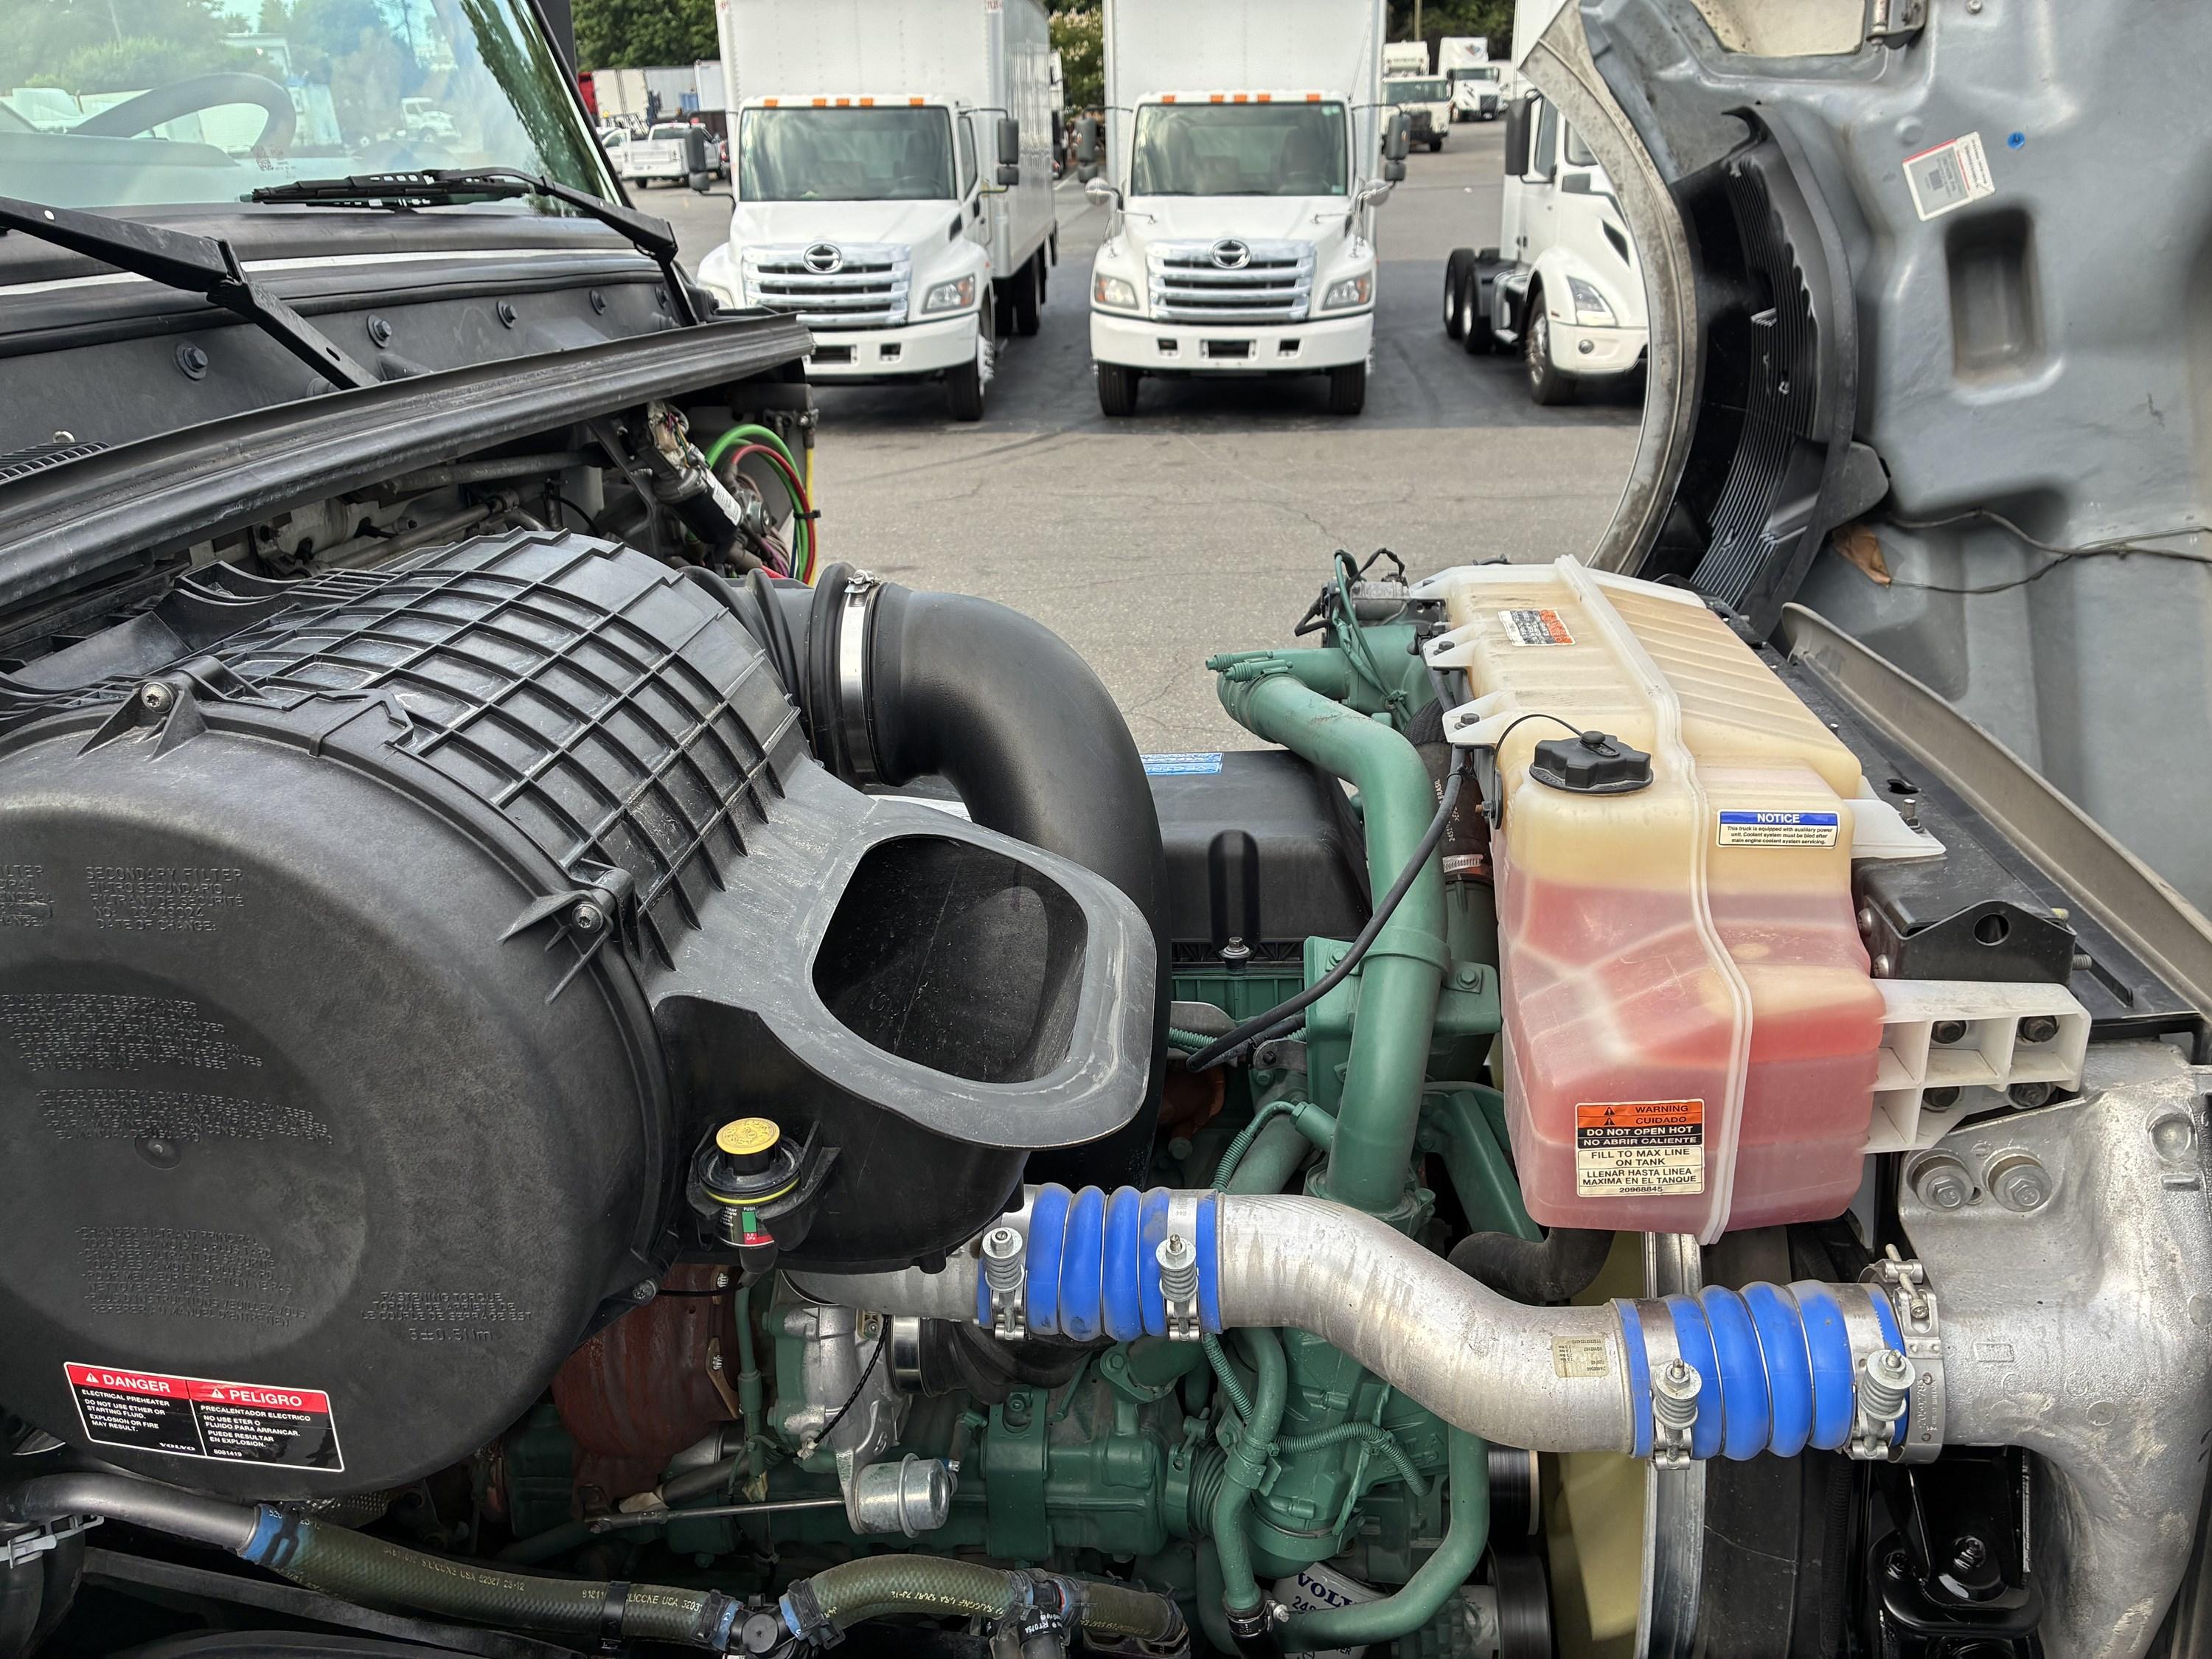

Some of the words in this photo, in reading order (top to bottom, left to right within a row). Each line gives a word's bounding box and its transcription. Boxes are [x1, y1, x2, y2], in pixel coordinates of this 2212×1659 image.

[1757, 813, 1800, 823] NOTICE
[86, 866, 176, 880] SECONDARY
[184, 868, 244, 882] FILTER
[88, 881, 133, 893] FILTRO
[137, 882, 224, 894] SECUNDARIO
[97, 919, 133, 930] DATE
[136, 919, 153, 930] OF
[157, 919, 217, 931] CHANGE:
[1635, 1105, 1688, 1113] WARNING
[1635, 1116, 1687, 1124] CUIDADO
[1634, 1127, 1666, 1135] OPEN
[1603, 1138, 1638, 1146] ABRIR
[1641, 1136, 1697, 1144] CALIENTE
[1591, 1151, 1614, 1159] FILL
[1636, 1149, 1661, 1157] MAX
[1664, 1148, 1690, 1156] LINE
[1615, 1158, 1632, 1166] ON
[1635, 1158, 1666, 1166] TANK
[1587, 1169, 1624, 1178] LLENAR
[1628, 1169, 1660, 1177] HASTA
[1663, 1167, 1691, 1175] LINEA
[1656, 1175, 1697, 1183] TANQUE
[381, 1291, 449, 1301] FASTENING
[453, 1293, 503, 1302] TORQUE
[361, 1310, 376, 1319] LE
[378, 1311, 425, 1321] COUPLE
[429, 1312, 445, 1321] DE
[448, 1312, 505, 1321] SERRAGE
[509, 1312, 532, 1321] EST
[102, 1374, 171, 1393] DANGER
[81, 1389, 126, 1401] ELECTRICAL
[126, 1395, 170, 1407] PREHEATER
[229, 1389, 302, 1407] PELIGRO
[87, 1405, 122, 1416] STARTING
[123, 1411, 147, 1419] FLUID.
[128, 1405, 153, 1413] ETHER
[201, 1405, 267, 1417] PRECALENTADOR
[268, 1413, 311, 1422] ELECTRICO
[89, 1413, 130, 1425] EXPLOSION
[108, 1422, 139, 1432] RESULT.
[205, 1422, 234, 1430] FLUIDO
[256, 1427, 301, 1437] ARRANCAR.
[208, 1430, 234, 1439] PUEDE
[234, 1433, 274, 1442] RESULTAR
[159, 1442, 195, 1451] VOLVO
[222, 1438, 266, 1448] EXPLOSION.
[662, 1596, 678, 1607] USA
